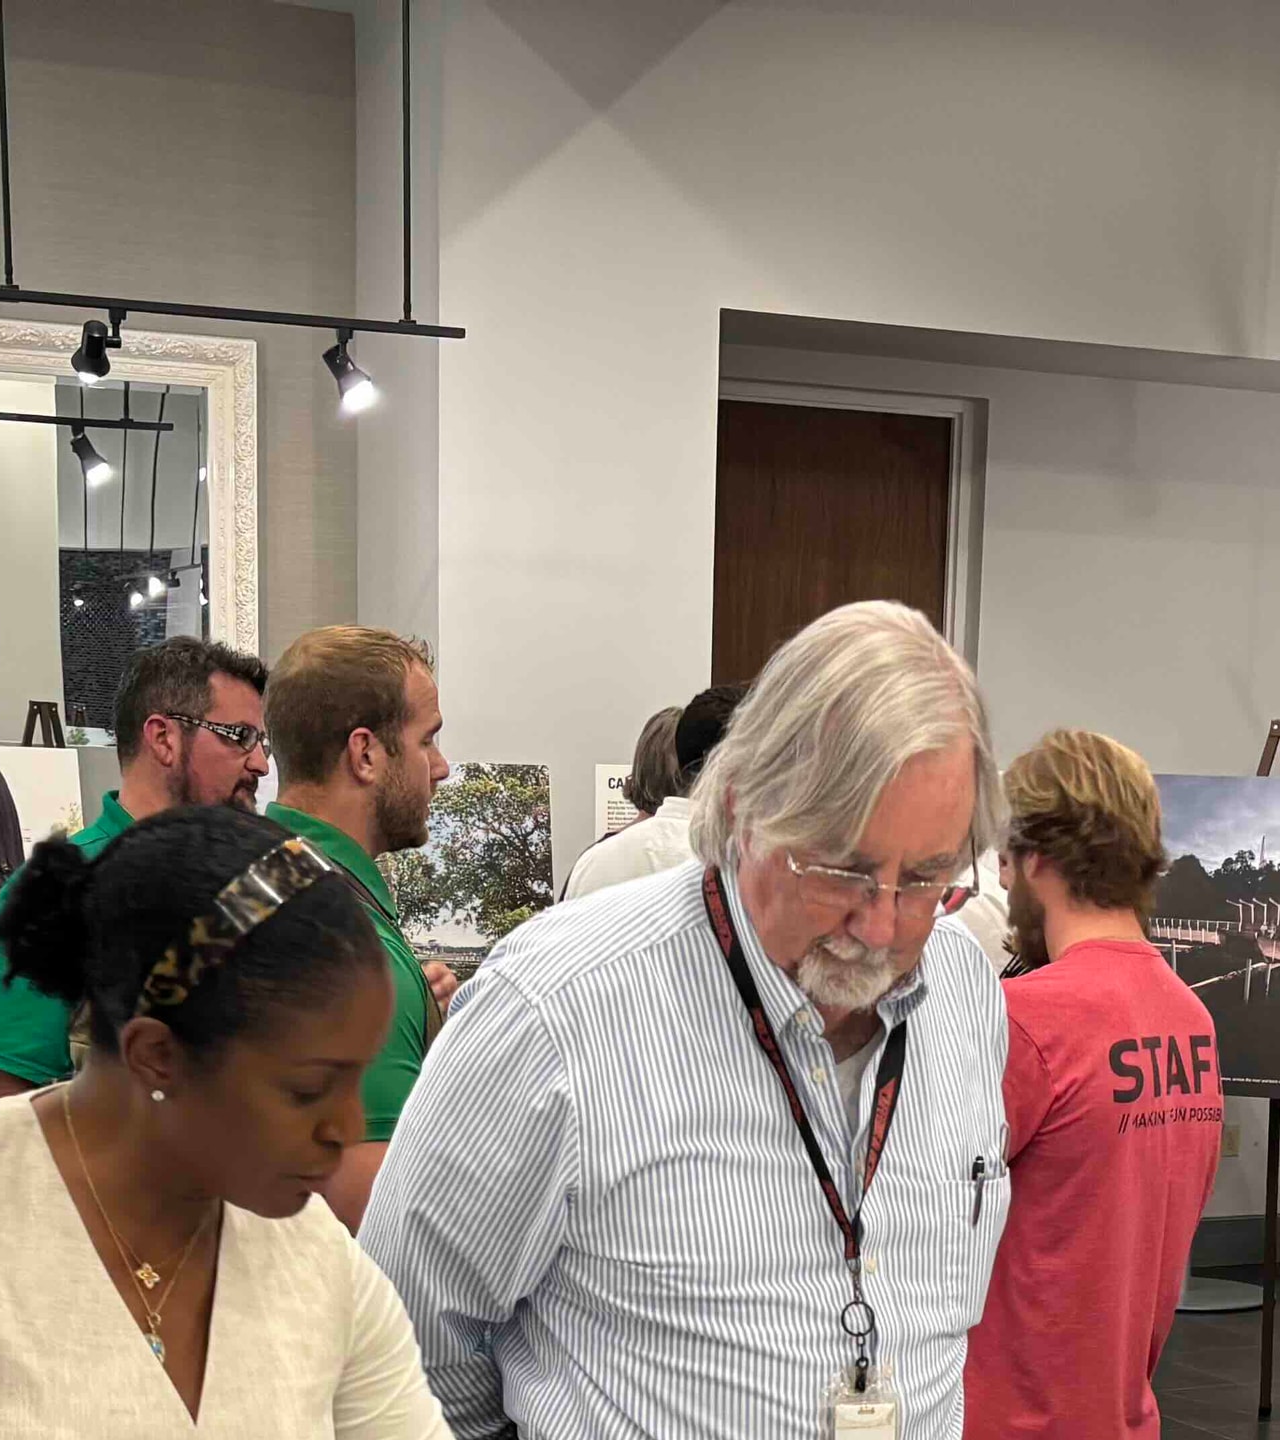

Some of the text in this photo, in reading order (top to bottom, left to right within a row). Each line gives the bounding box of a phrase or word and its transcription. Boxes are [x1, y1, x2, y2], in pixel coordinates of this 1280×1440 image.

[608, 777, 624, 789] CA
[1109, 1035, 1223, 1103] STAF
[1190, 1107, 1222, 1122] POSSIB
